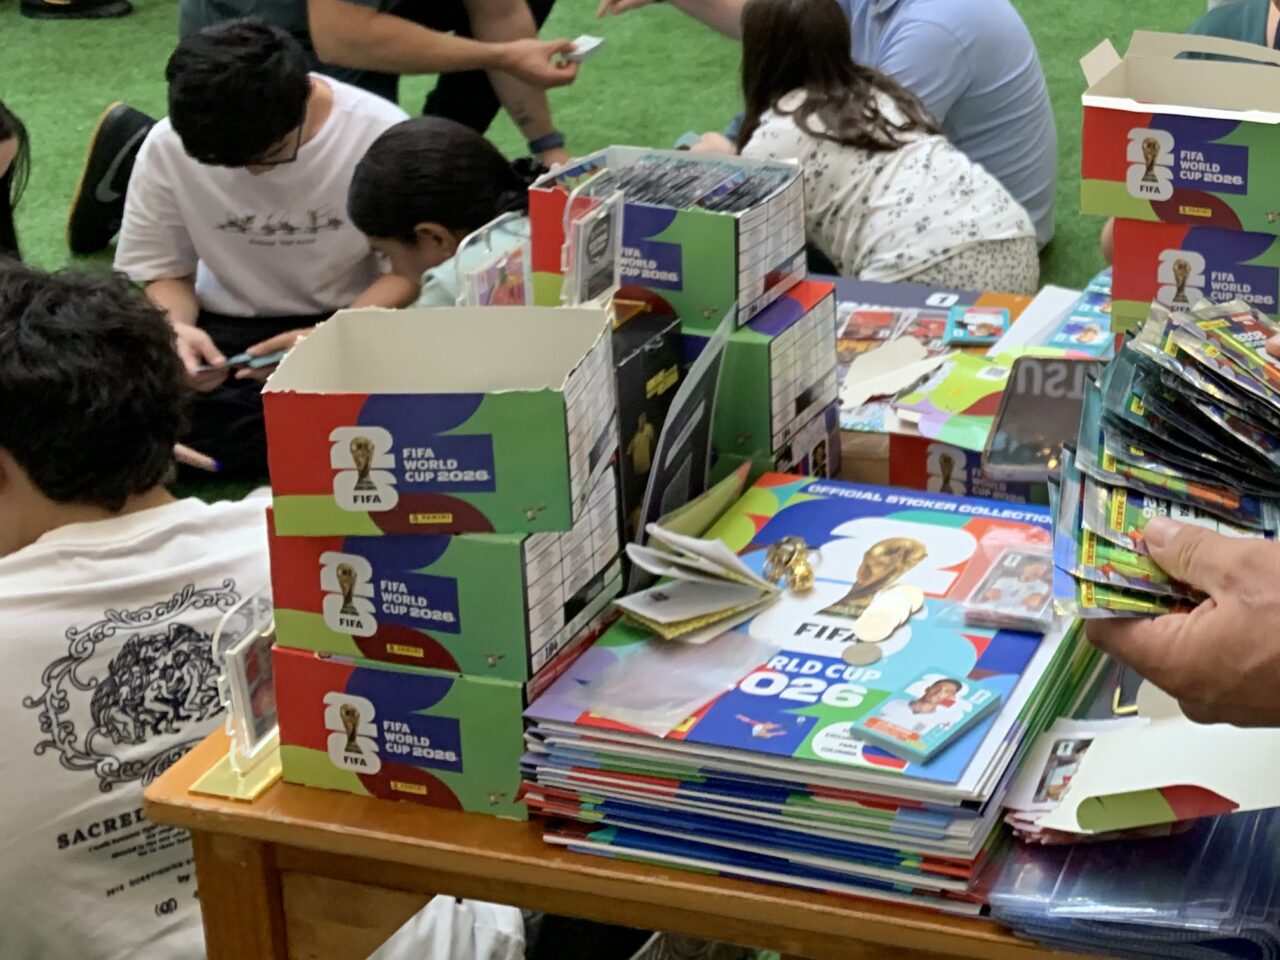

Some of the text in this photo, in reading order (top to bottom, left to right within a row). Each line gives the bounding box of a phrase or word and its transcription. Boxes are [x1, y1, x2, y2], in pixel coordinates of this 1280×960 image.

[1180, 150, 1204, 162] FIFA
[1180, 160, 1220, 173] WORLD
[1179, 170, 1243, 185] CUP 2026
[1139, 184, 1161, 194] FIFA
[1211, 271, 1235, 282] FIFA
[1210, 281, 1251, 293] WORLD
[1210, 290, 1233, 301] CUP
[403, 447, 435, 459] FIFA
[403, 459, 457, 470] WORLD
[405, 470, 489, 482] CUP 2026
[353, 495, 381, 504] FIFA
[807, 484, 1052, 524] OFFICIAL STICKER COLLECTIO
[380, 580, 408, 594] FIFA
[381, 592, 427, 607] WORLD
[382, 603, 456, 623] CUP 2026
[339, 618, 363, 629] FIFA
[766, 656, 883, 682] RLD CUP
[728, 670, 868, 708] 026
[383, 720, 411, 734] FIFA
[384, 732, 430, 747] WORLD
[385, 743, 458, 762] CUP 2026
[344, 755, 367, 767] FIFA
